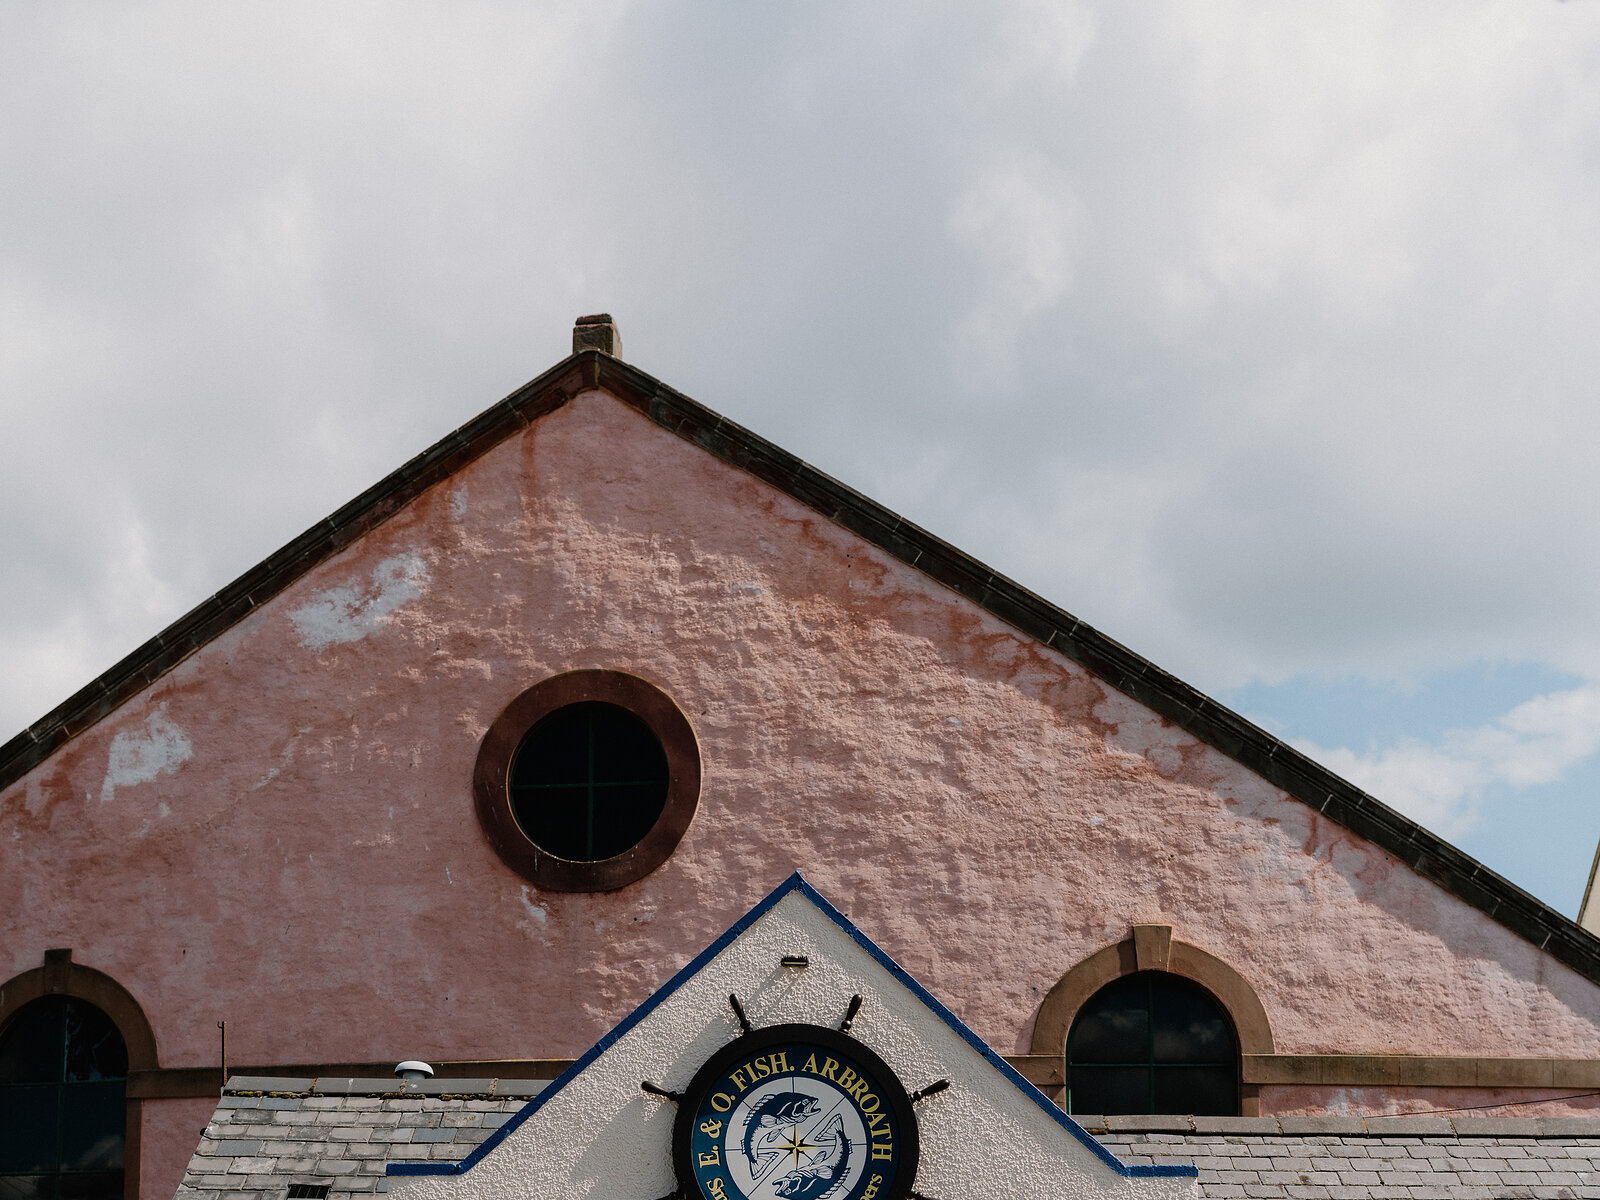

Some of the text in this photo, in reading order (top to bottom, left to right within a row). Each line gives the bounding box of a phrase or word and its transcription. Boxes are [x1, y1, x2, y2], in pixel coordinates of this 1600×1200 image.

[711, 1092, 736, 1113] O.
[801, 1052, 893, 1162] ARBROATH
[700, 1117, 723, 1139] &
[698, 1145, 720, 1168] E.
